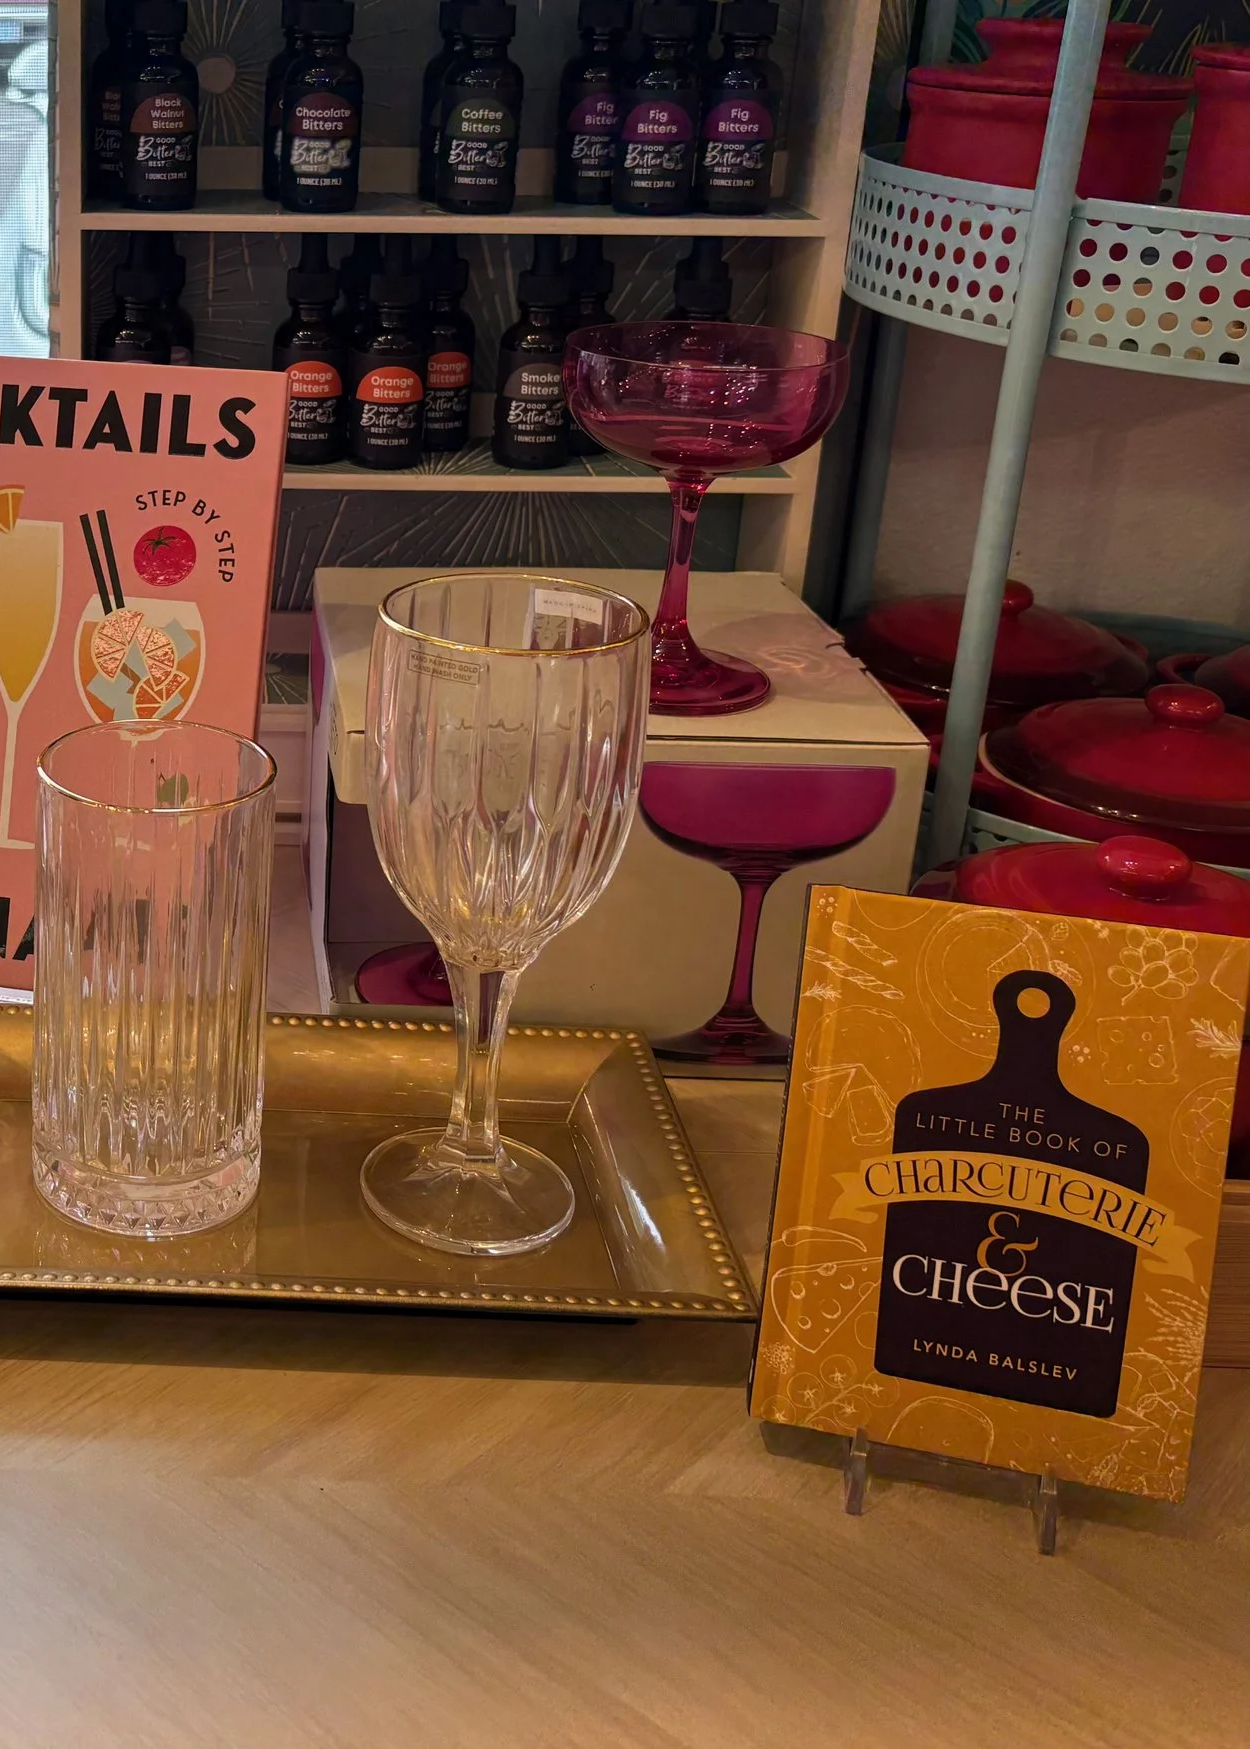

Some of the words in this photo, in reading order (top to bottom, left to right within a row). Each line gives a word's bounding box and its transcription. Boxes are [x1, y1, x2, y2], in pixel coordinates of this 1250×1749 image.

[155, 98, 181, 107] Black
[596, 102, 614, 113] Fig
[151, 110, 184, 118] Walnut
[296, 107, 351, 118] Chocolate
[461, 108, 503, 120] Coffee
[650, 110, 669, 122] Fig
[731, 108, 750, 121] Fig
[153, 120, 183, 129] Bitters
[302, 119, 344, 130] Bitters
[585, 115, 618, 125] Bitter
[461, 122, 502, 133] Bitters
[637, 123, 678, 134] Bitters
[718, 122, 759, 133] Bitters
[457, 177, 476, 185] OUNCE
[427, 361, 467, 373] Orange
[290, 371, 333, 382] Orange
[371, 376, 414, 388] Orange
[429, 373, 465, 383] Bitters
[521, 373, 561, 383] Smoke
[292, 383, 330, 393] Bitters
[373, 388, 411, 398] Bitters
[521, 385, 559, 395] Bitters
[135, 489, 186, 511] STEP
[191, 499, 221, 524] BY
[214, 530, 235, 583] STEP
[429, 657, 456, 670] PAINTED
[458, 663, 478, 674] GOLD
[432, 667, 451, 678] WASH
[453, 672, 472, 681] ONLY
[999, 1102, 1045, 1124] THE
[916, 1112, 996, 1139] LITTLE
[1009, 1127, 1081, 1153] BOOK
[1093, 1140, 1128, 1159] OF
[976, 1211, 1039, 1278] &
[913, 1338, 978, 1363] LYNDA
[988, 1351, 1078, 1381] BALSLEV
